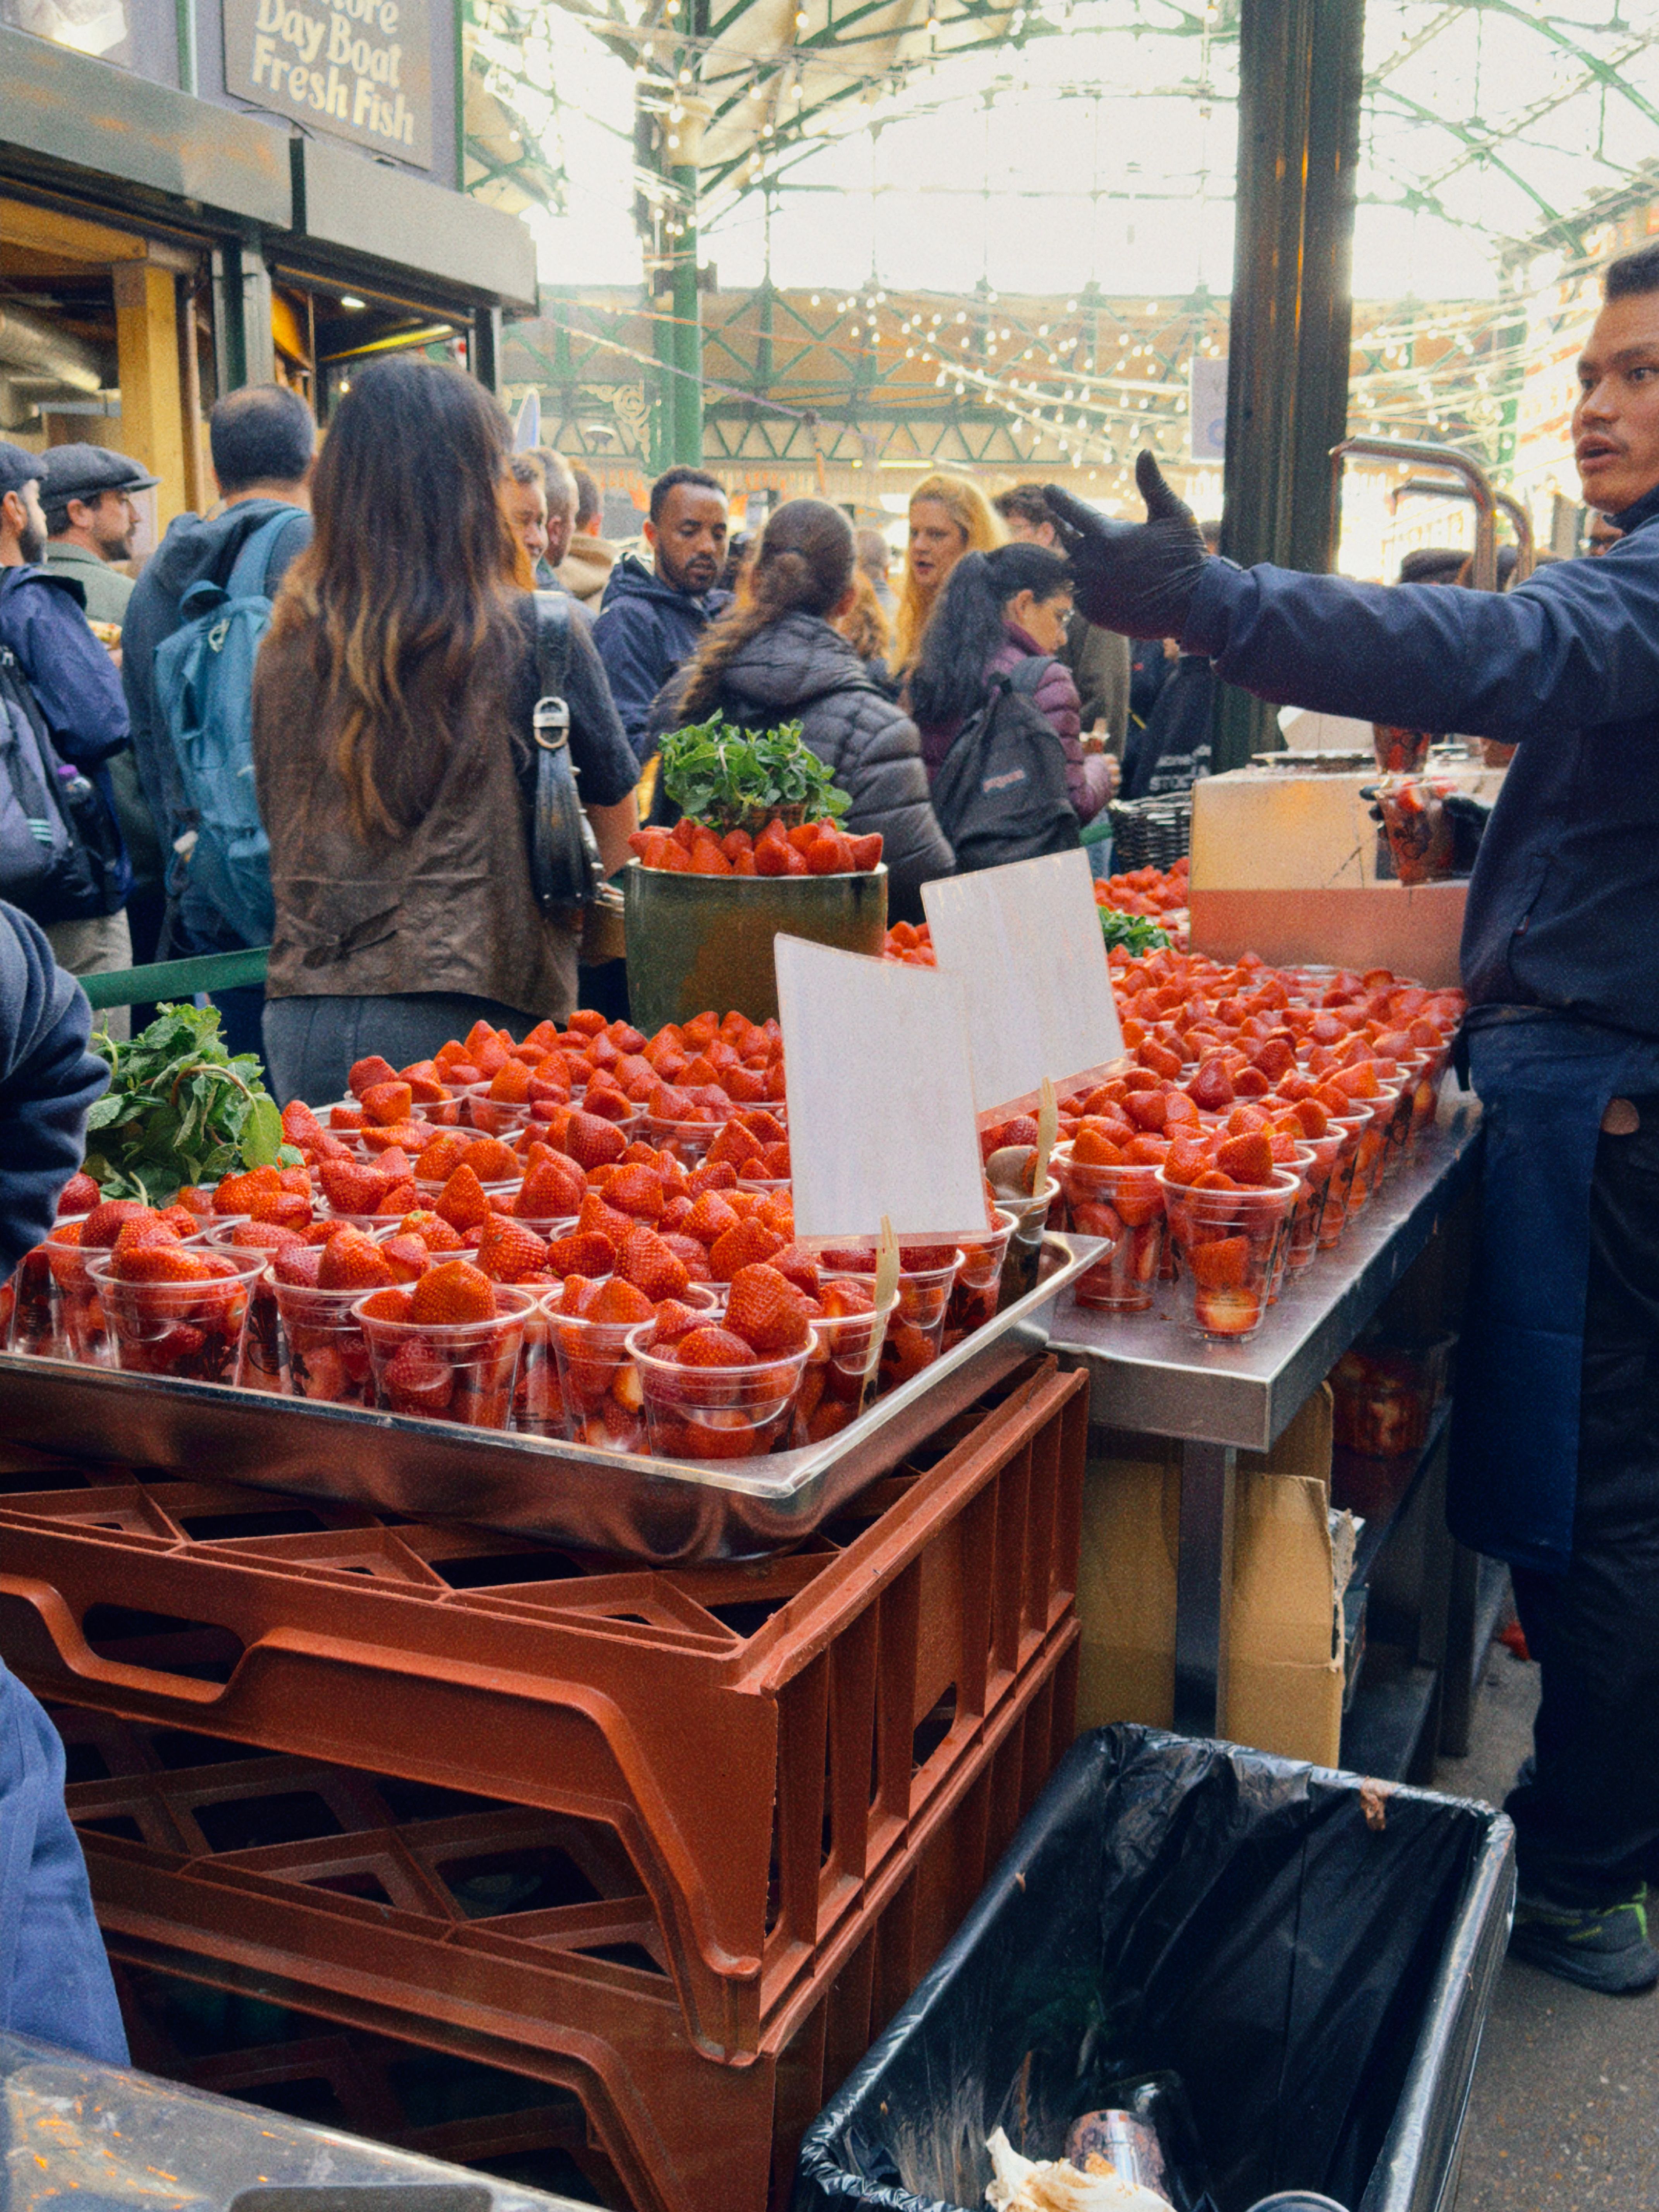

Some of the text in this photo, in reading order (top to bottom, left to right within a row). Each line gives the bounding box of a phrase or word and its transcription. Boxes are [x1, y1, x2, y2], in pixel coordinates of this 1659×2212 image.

[252, 34, 414, 144] Fresh Fish
[256, 0, 402, 89] Day Boat
